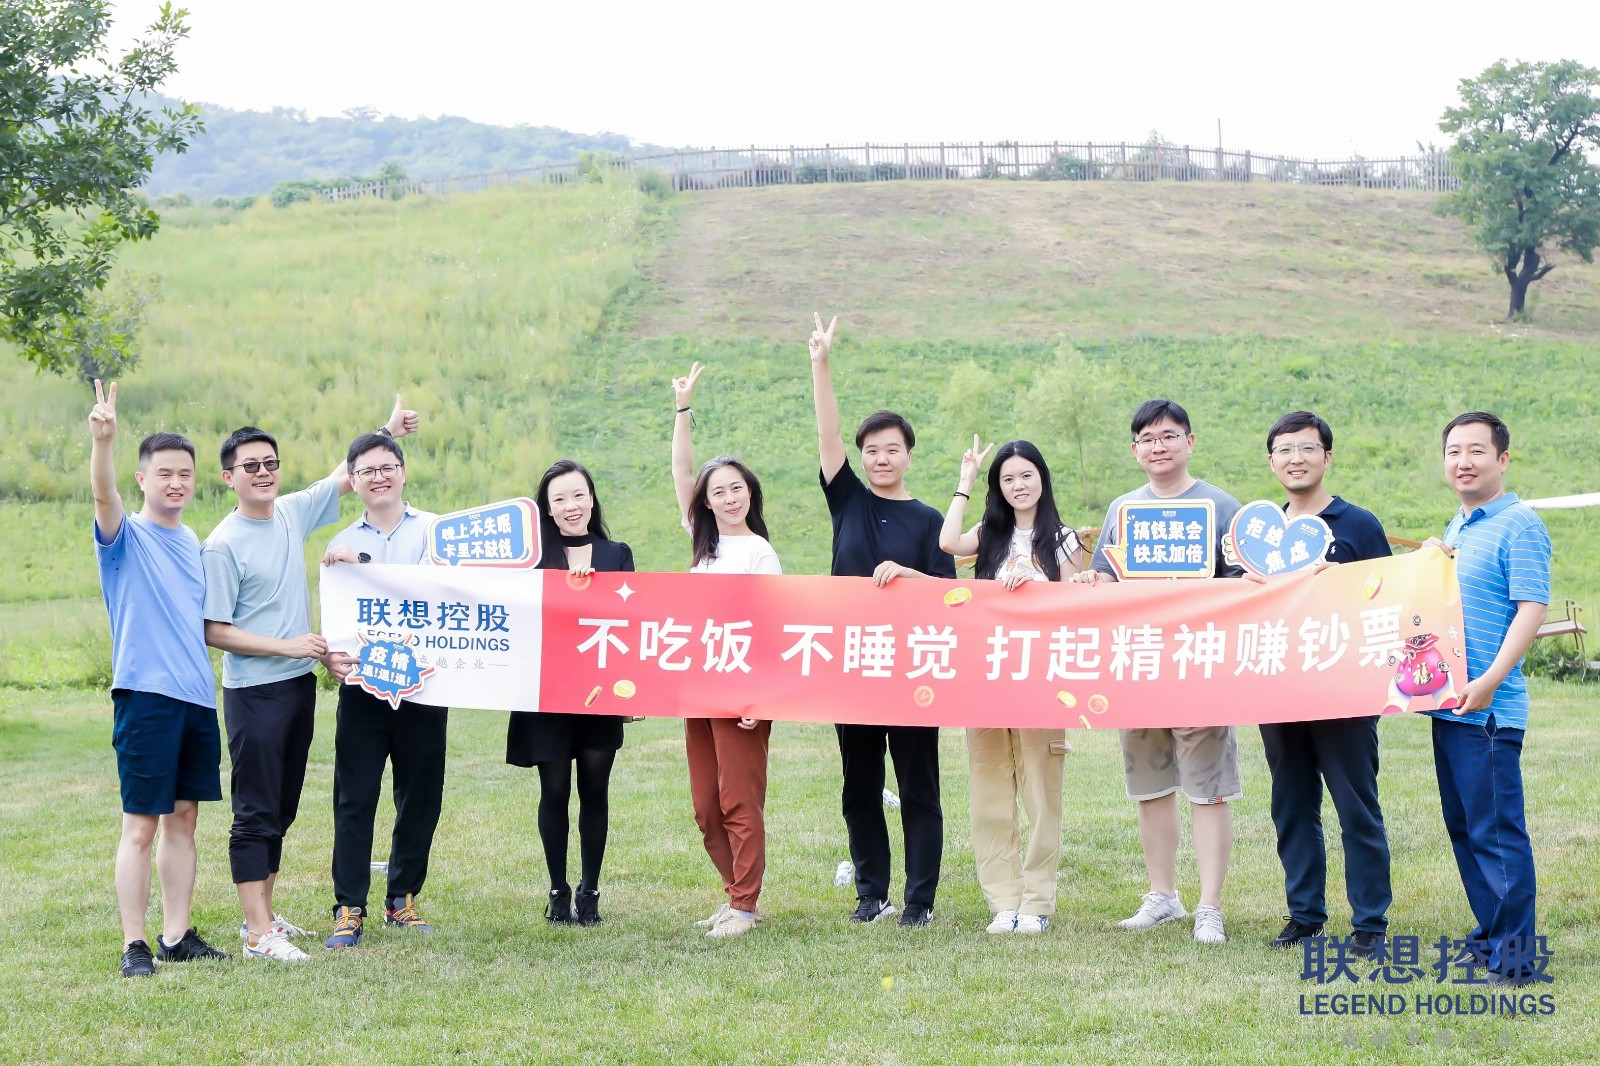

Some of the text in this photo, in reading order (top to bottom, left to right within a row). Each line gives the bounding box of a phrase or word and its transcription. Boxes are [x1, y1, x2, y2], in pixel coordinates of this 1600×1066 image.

[441, 512, 512, 541] 晚上不失眠
[1133, 520, 1204, 541] 搞钱聚会
[1245, 516, 1285, 548] 拒绝
[443, 537, 514, 559] 卡里不缺钱
[1133, 544, 1204, 564] 快乐加倍
[1264, 540, 1310, 575] 焦虑
[356, 597, 511, 633] 联想控股
[425, 635, 510, 652] HOLDINGS
[577, 604, 1406, 682] 不吃饭 不睡觉 打起精神赚钞票
[368, 646, 410, 672] 疫情
